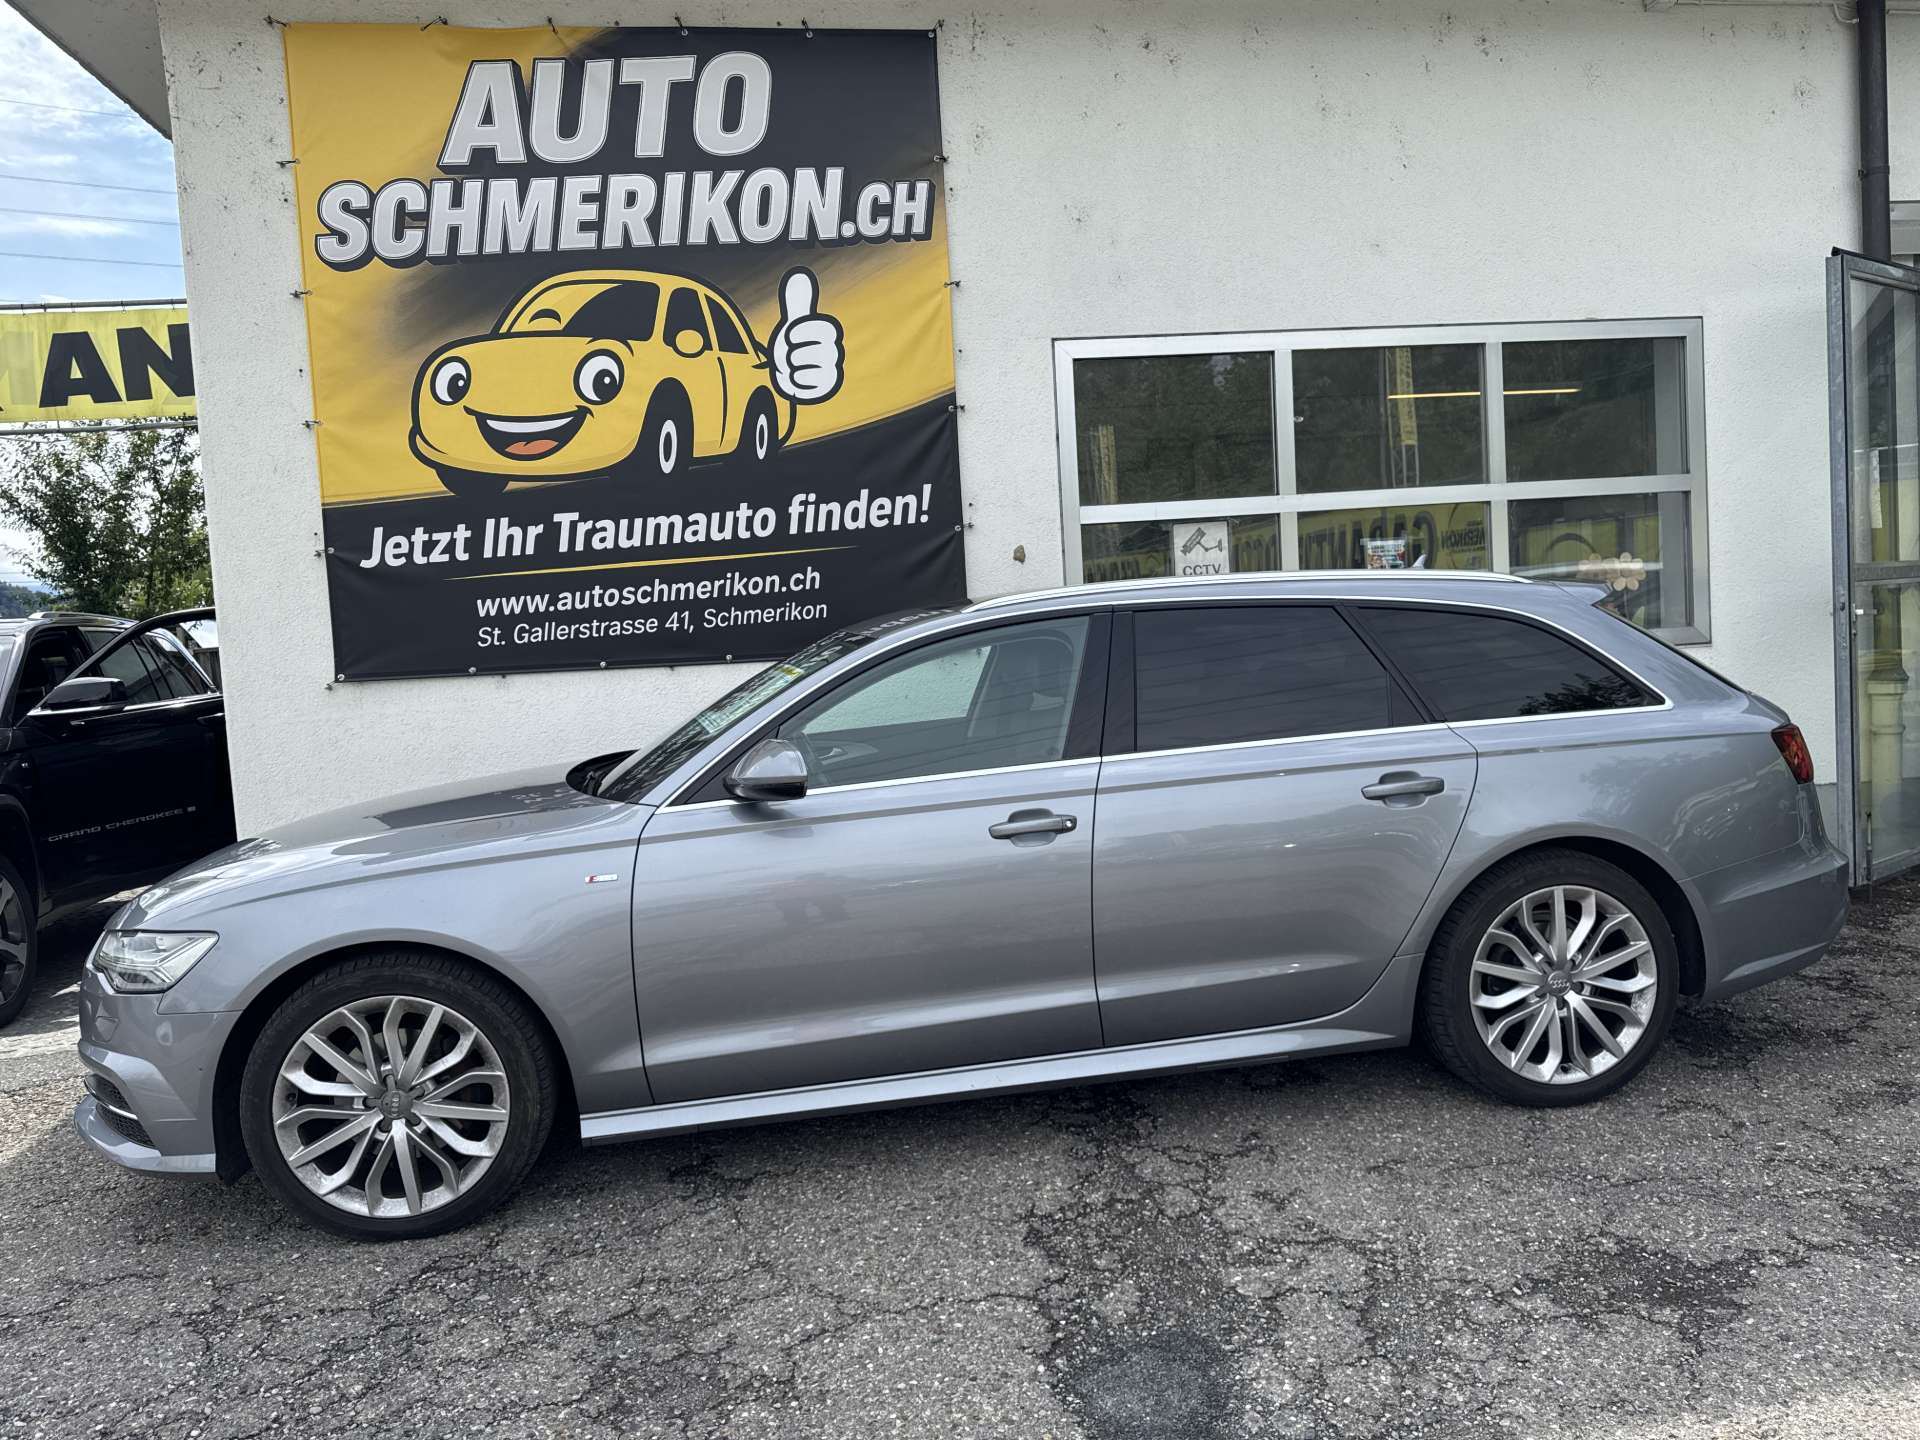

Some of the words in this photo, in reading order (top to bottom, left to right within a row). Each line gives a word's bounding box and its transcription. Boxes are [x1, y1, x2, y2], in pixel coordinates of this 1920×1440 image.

[440, 51, 772, 166] AUTO
[316, 166, 933, 263] SCHMERIKON.CH
[359, 523, 472, 569] Jetzt
[483, 517, 544, 559] Ihr
[552, 502, 778, 553] Traumauto
[788, 484, 933, 536] finden!
[476, 566, 821, 618] www.autoschmerikon.ch
[1182, 563, 1222, 576] CCTV
[477, 626, 506, 648] St.
[513, 617, 659, 644] Gallerstrasse
[664, 610, 694, 634] 41,
[703, 601, 828, 628] Schmerikon
[47, 825, 102, 842] GRAND
[104, 807, 184, 830] CHEROKEE
